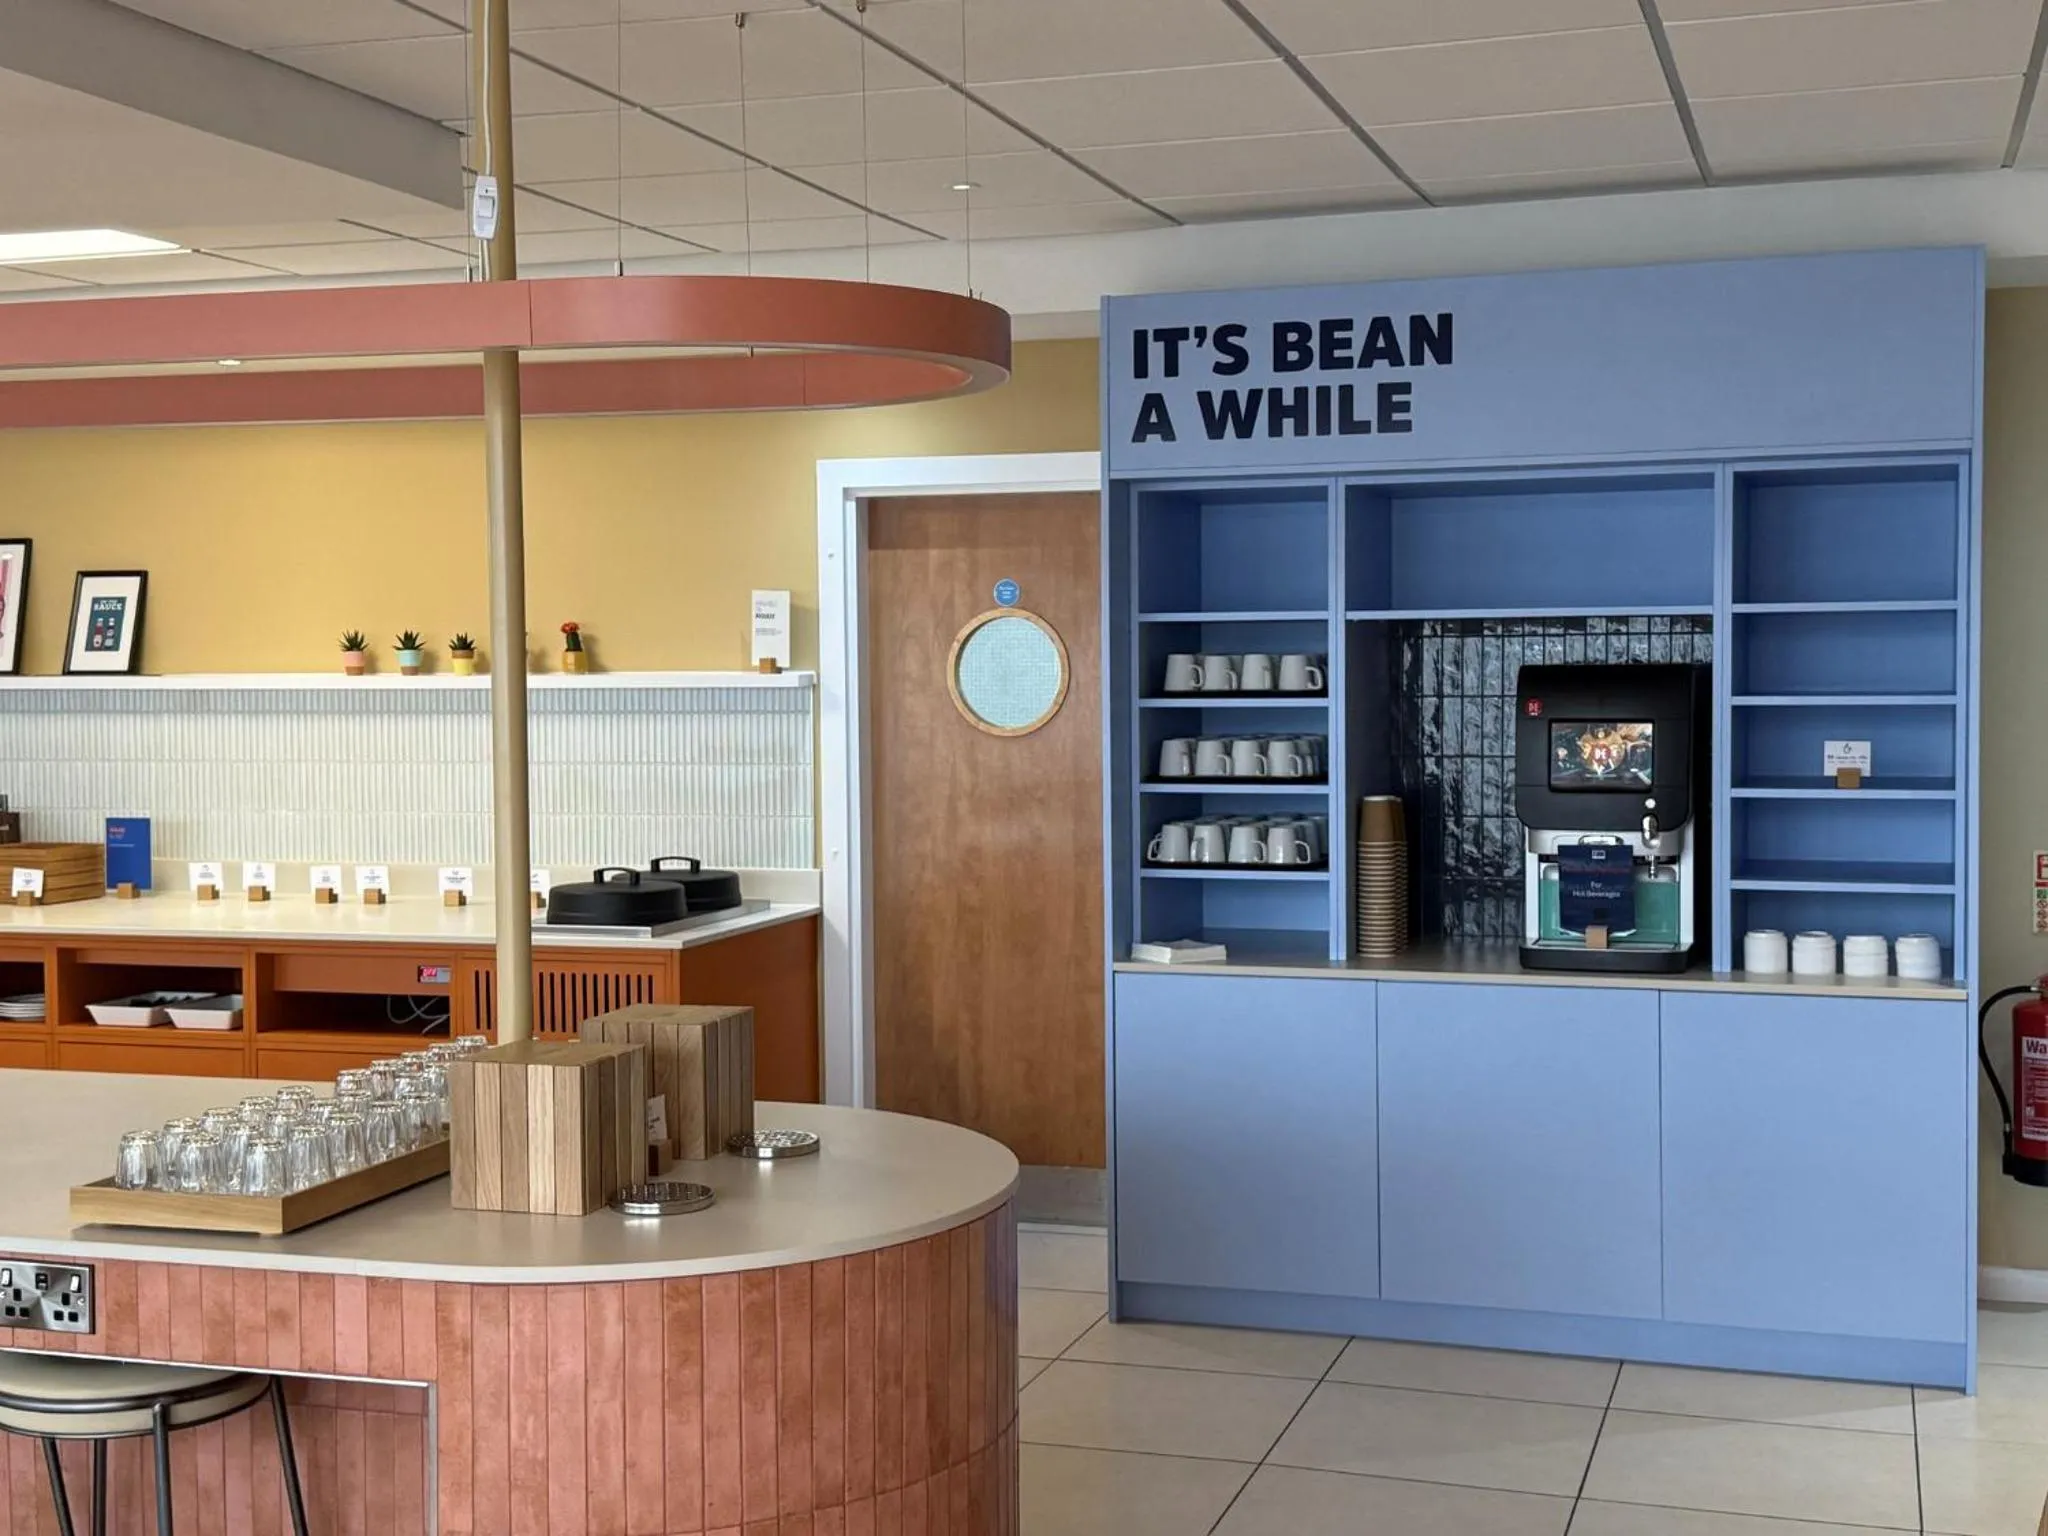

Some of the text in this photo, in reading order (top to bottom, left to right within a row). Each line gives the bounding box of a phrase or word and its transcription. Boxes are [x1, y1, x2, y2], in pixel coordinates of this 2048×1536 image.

[1133, 312, 1453, 379] IT’S BEAN
[1131, 381, 1413, 443] A WHILE
